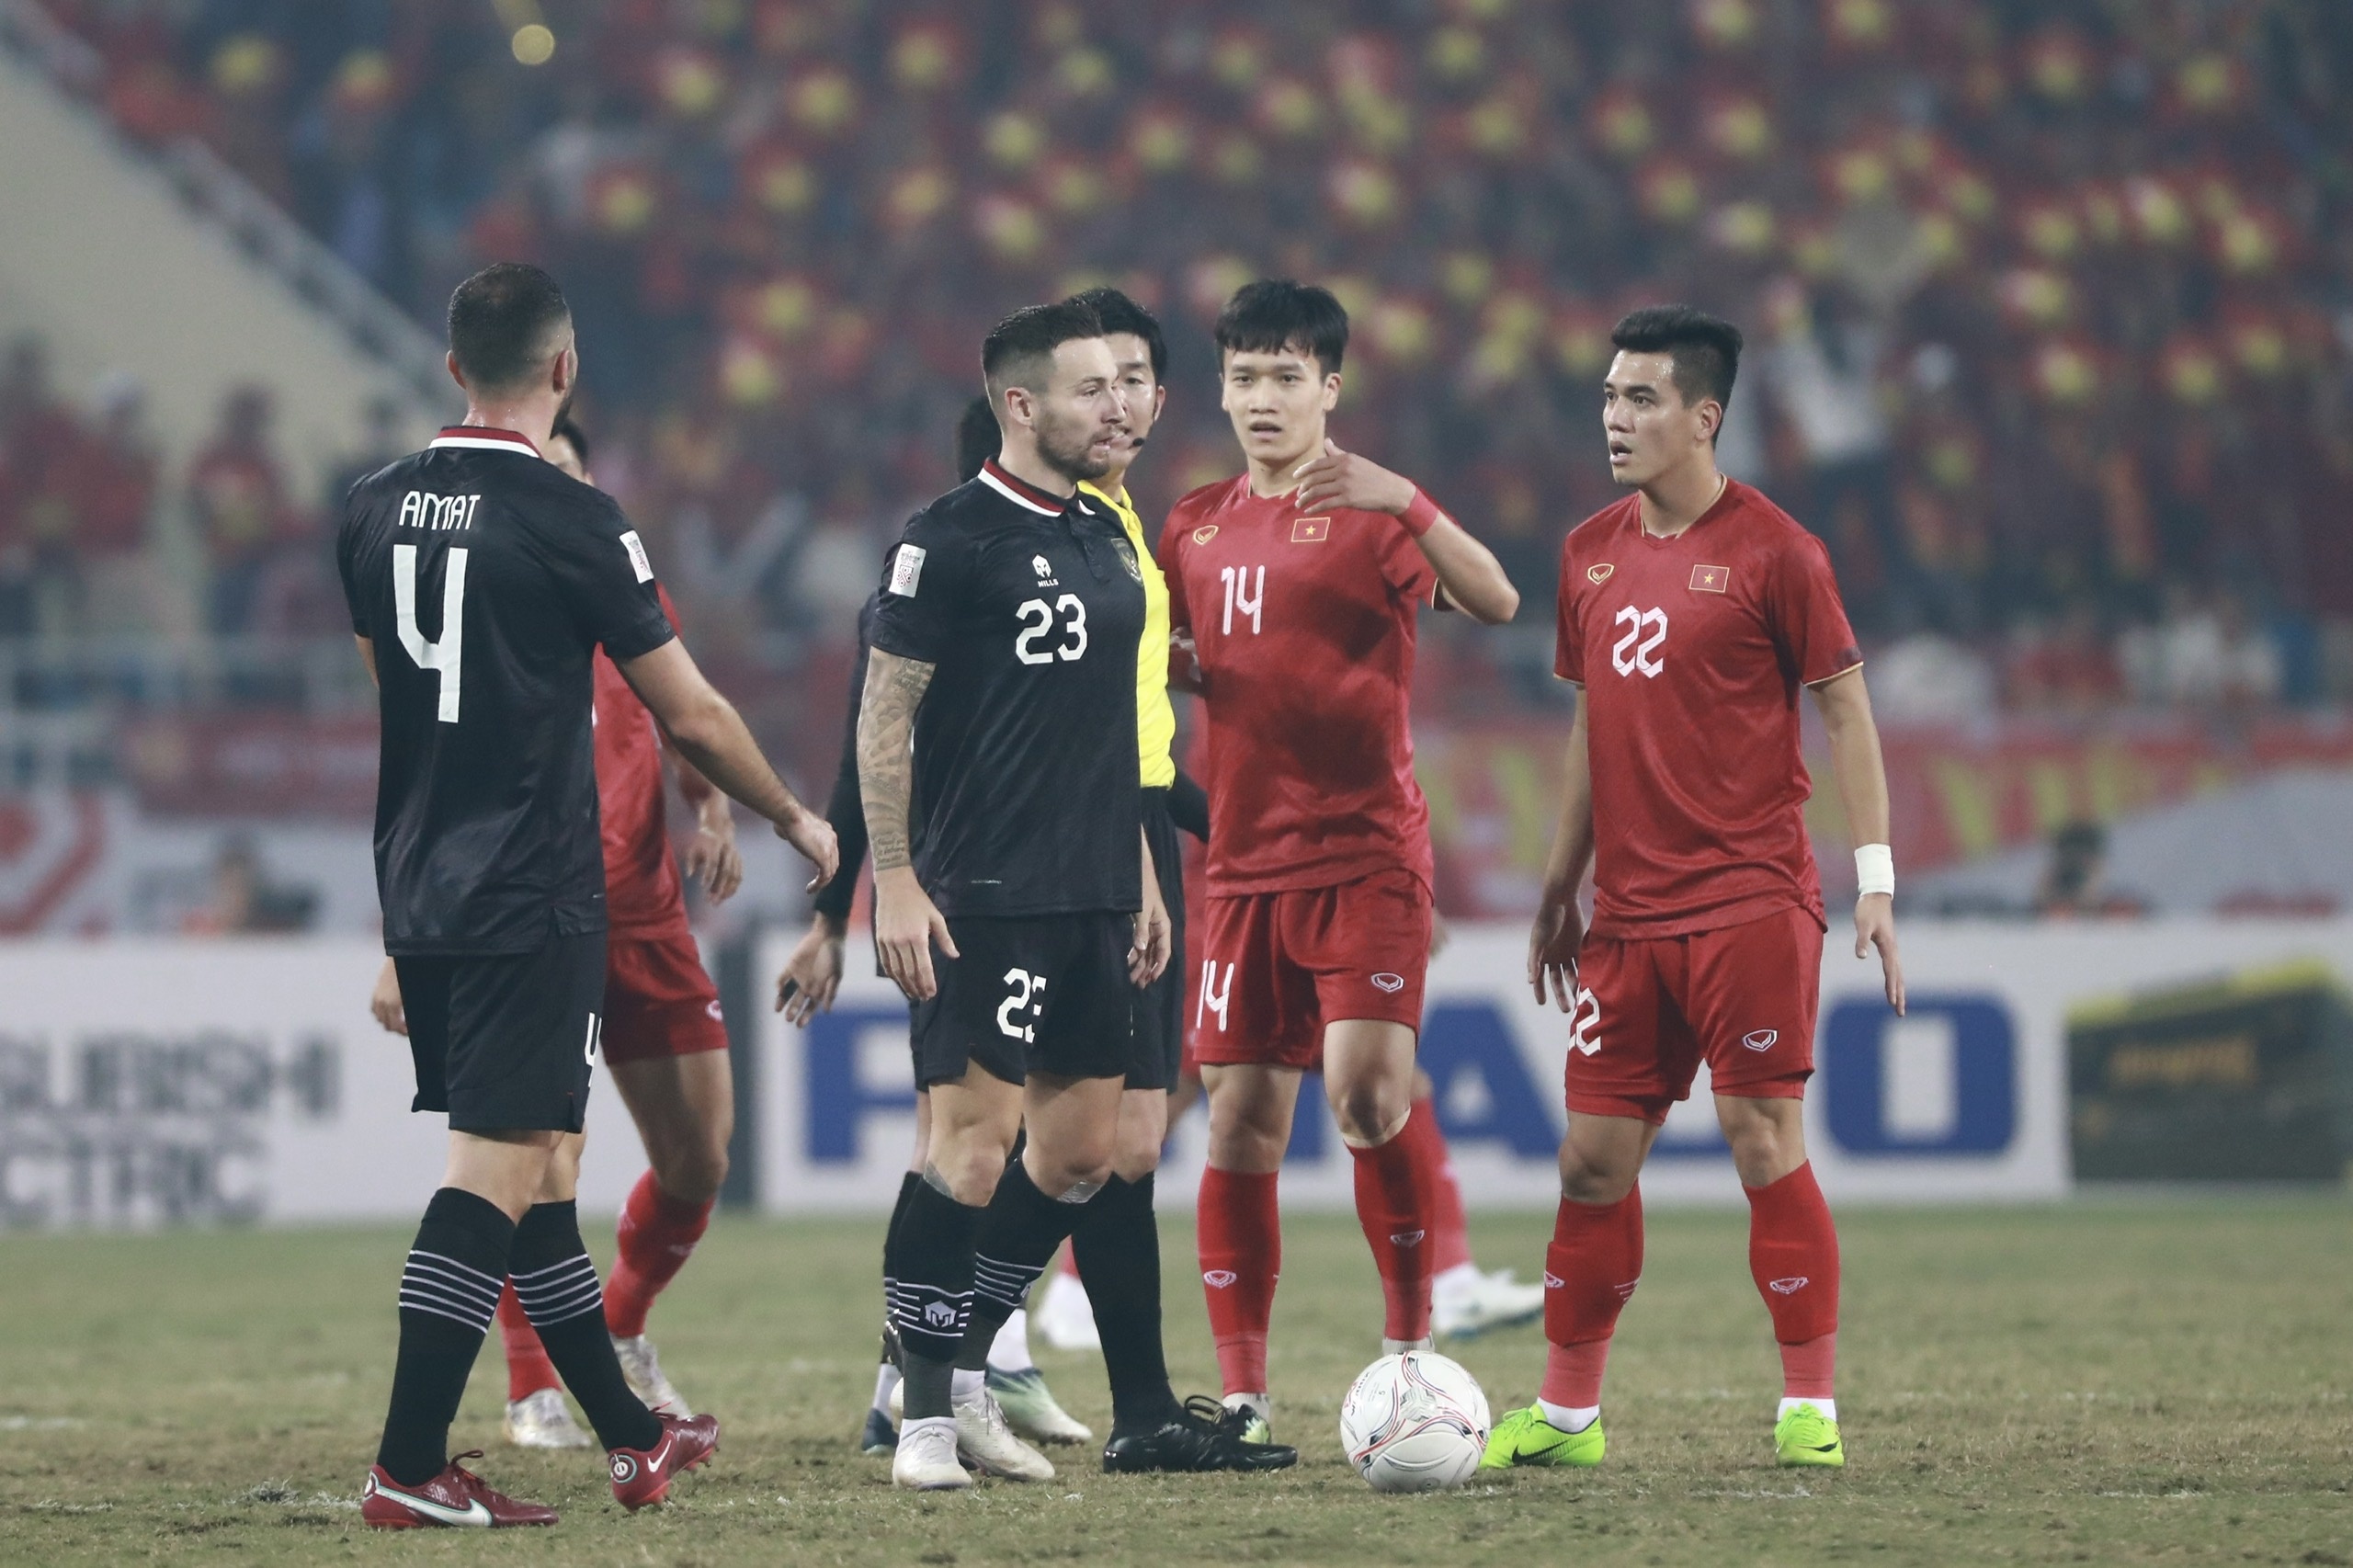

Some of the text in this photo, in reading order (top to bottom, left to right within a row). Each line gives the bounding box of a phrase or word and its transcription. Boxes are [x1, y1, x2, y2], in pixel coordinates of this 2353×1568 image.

[398, 491, 481, 530] AMAT
[1037, 578, 1059, 587] MILLS
[1221, 564, 1266, 635] 14
[393, 544, 468, 723] 4
[1016, 593, 1087, 665] 23
[1612, 605, 1668, 678] 22
[1197, 959, 1234, 1031] 14
[1568, 983, 1601, 1056] 2
